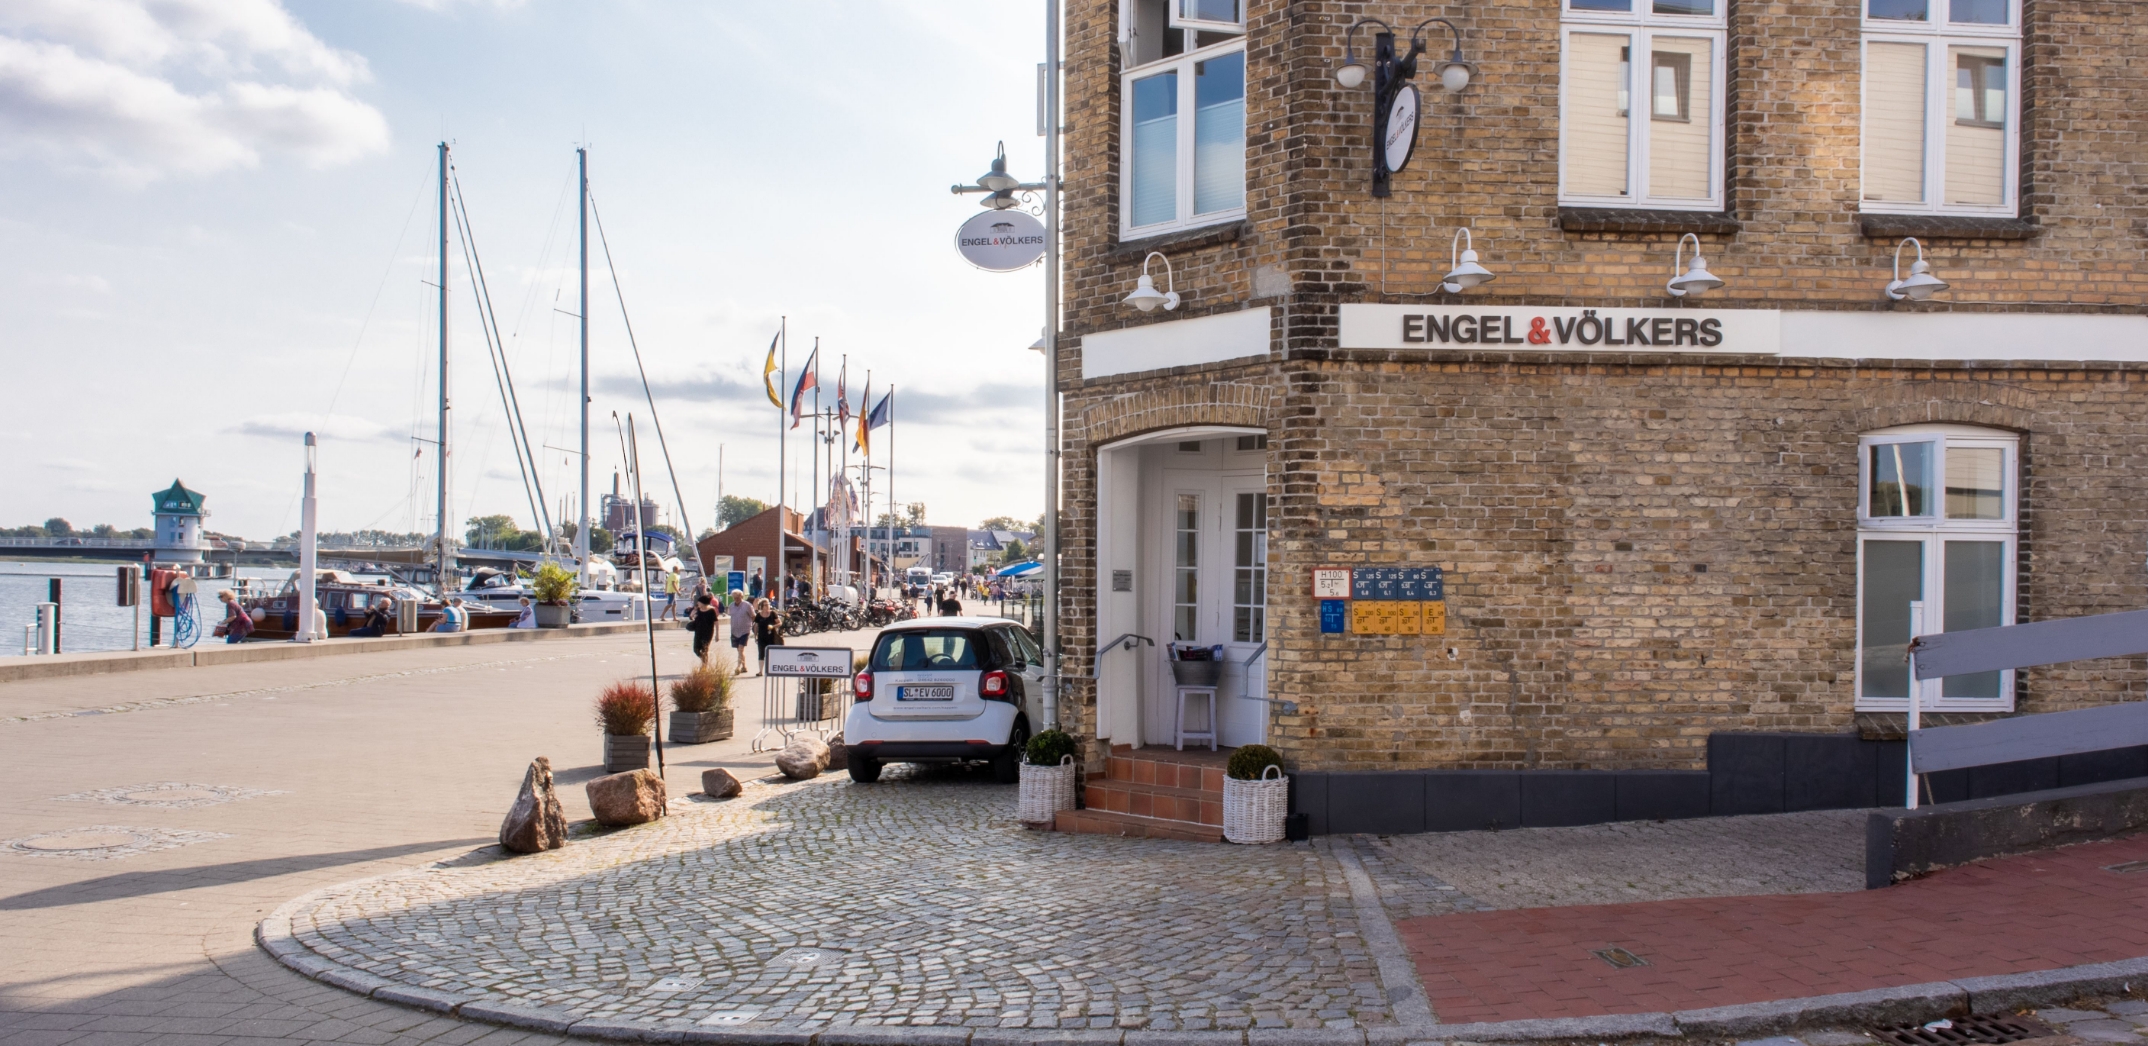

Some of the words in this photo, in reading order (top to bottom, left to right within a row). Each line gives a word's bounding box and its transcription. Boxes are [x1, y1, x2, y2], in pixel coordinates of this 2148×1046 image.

[961, 235, 1044, 247] ENGEL&VÖLKERS
[1402, 309, 1724, 346] ENGEL&VÖLKERS
[1353, 571, 1359, 579] S
[1375, 571, 1382, 579] S
[1398, 572, 1404, 580] S
[1420, 572, 1427, 580] S
[1353, 608, 1359, 616] S
[1376, 608, 1382, 616] S
[1399, 608, 1404, 616] S
[1428, 608, 1434, 616] E
[772, 664, 844, 673] ENGEL&VÖLKERS
[903, 687, 914, 698] SL
[919, 687, 930, 698] EV
[931, 687, 952, 697] 6000
